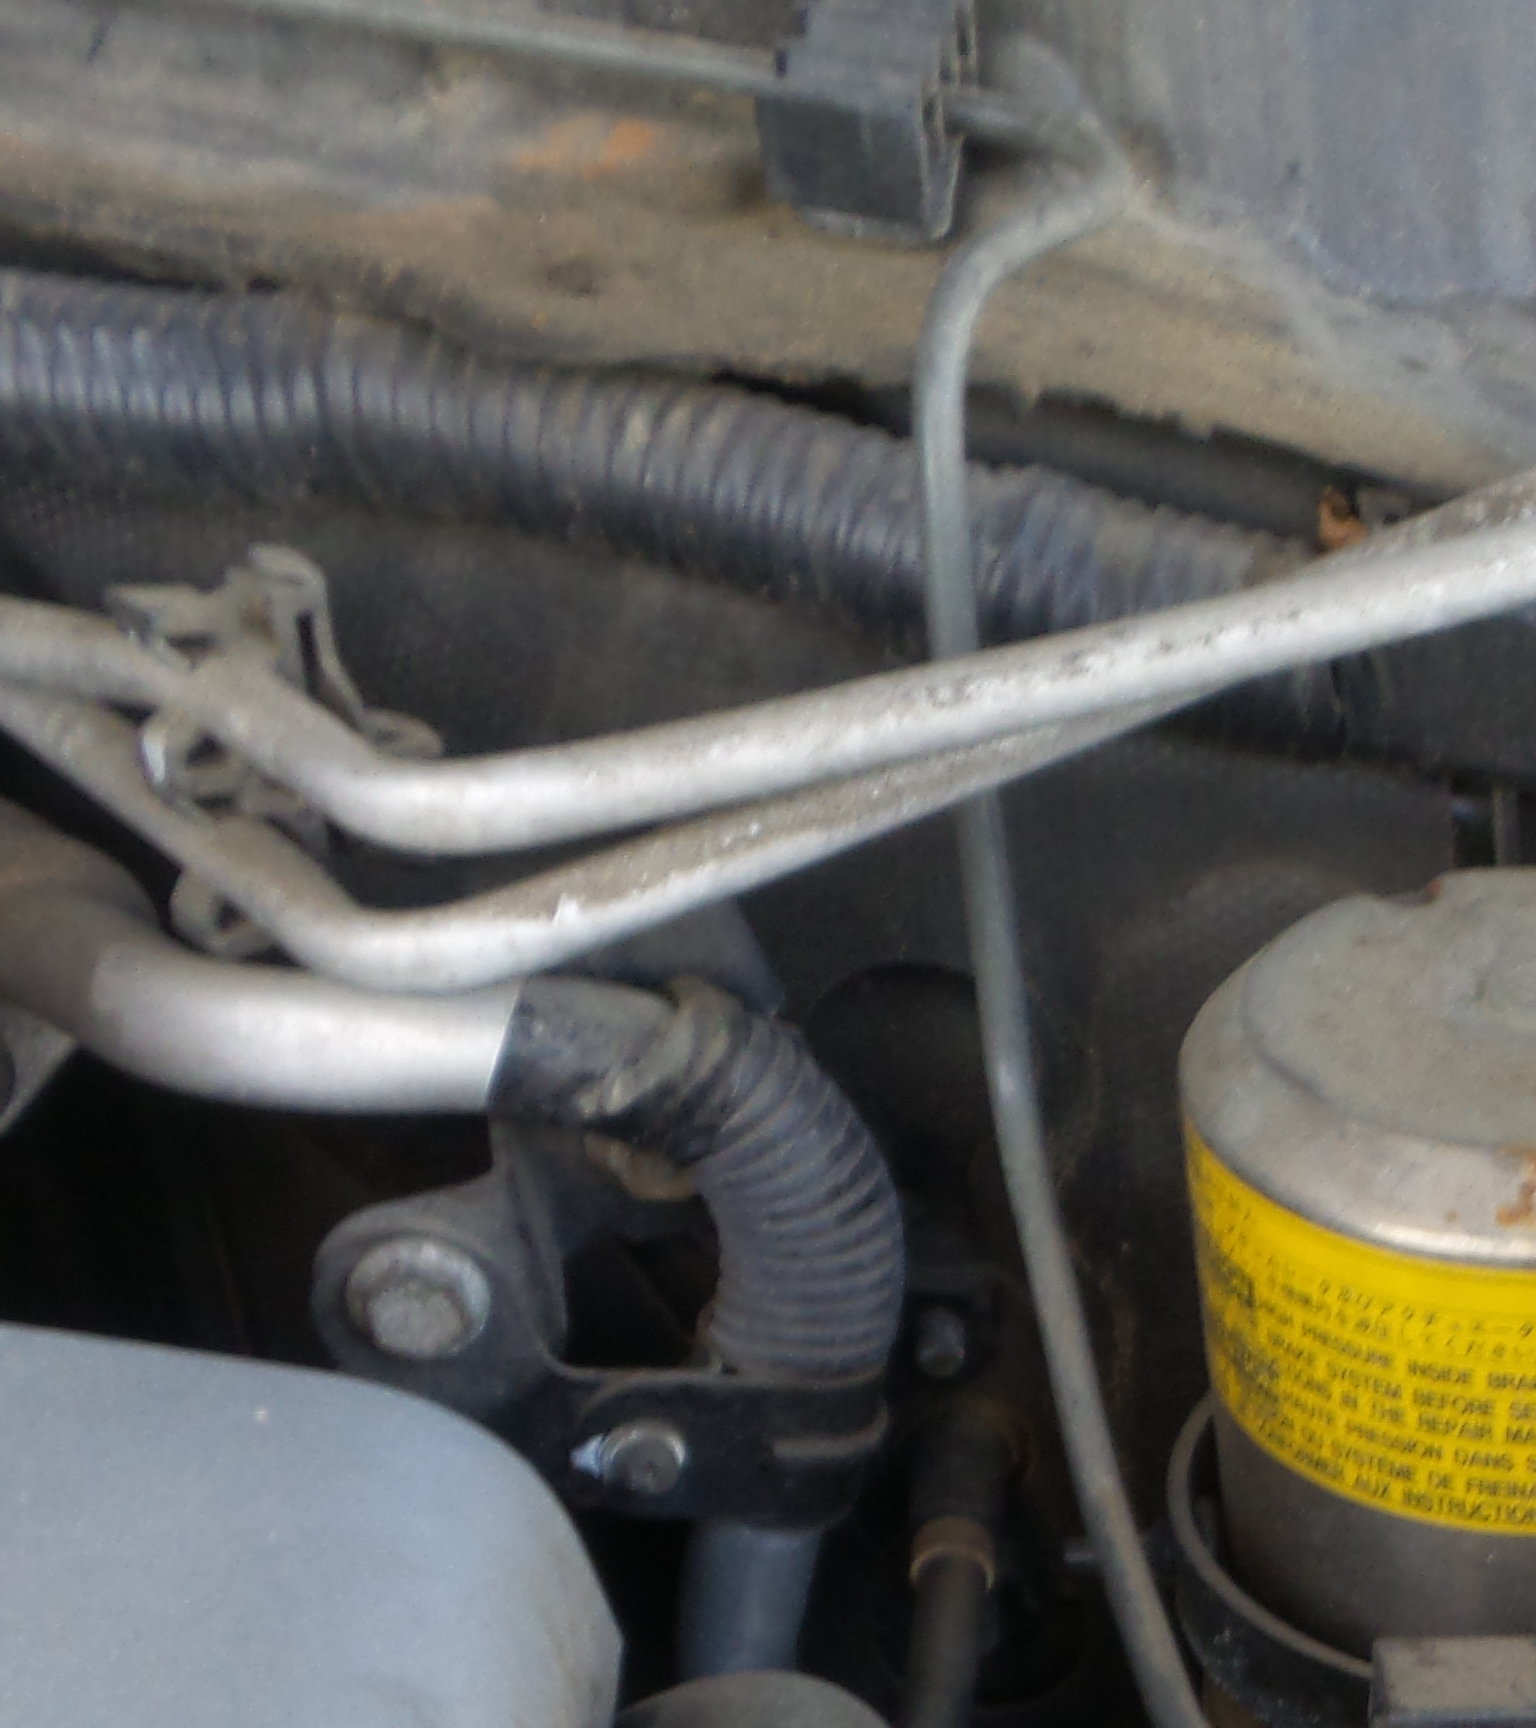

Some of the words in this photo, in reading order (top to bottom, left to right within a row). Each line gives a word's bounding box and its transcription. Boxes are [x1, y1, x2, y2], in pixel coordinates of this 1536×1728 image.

[1407, 1359, 1473, 1386] INSIDE
[1412, 1387, 1495, 1413] BEFORE
[1416, 1410, 1494, 1438] REPAIR
[1453, 1446, 1515, 1472] DANS
[1426, 1469, 1456, 1489] DE
